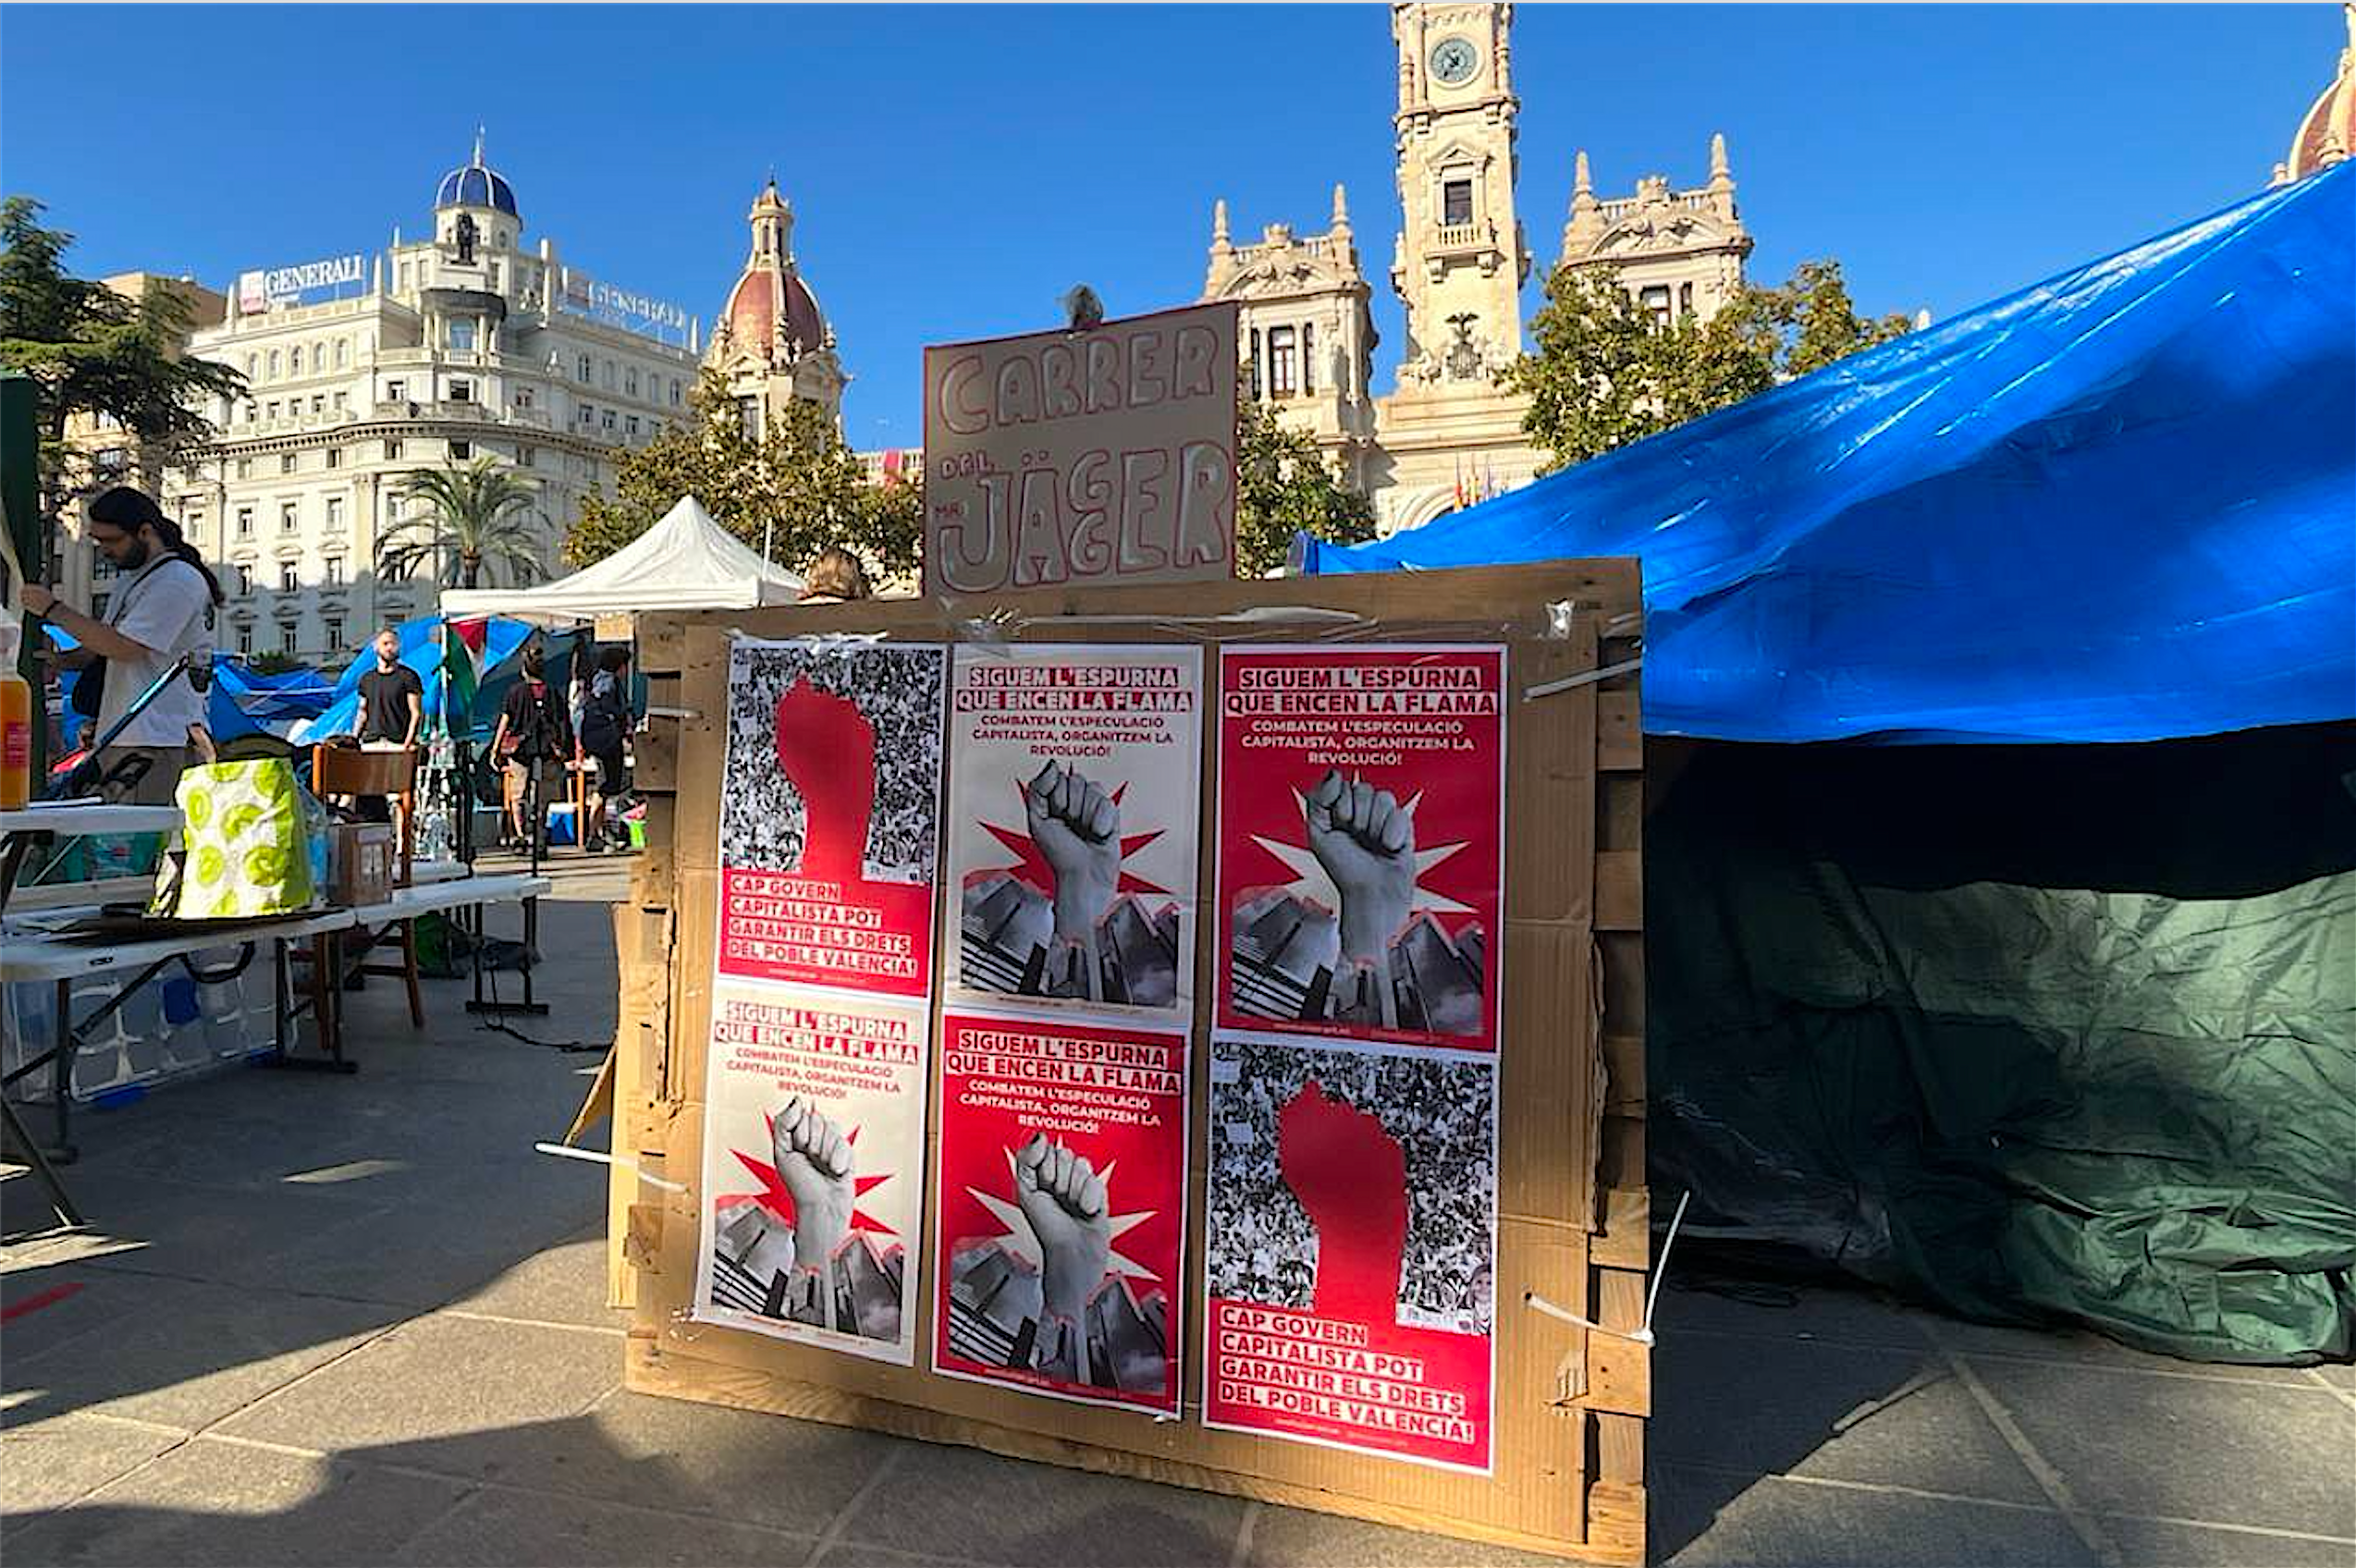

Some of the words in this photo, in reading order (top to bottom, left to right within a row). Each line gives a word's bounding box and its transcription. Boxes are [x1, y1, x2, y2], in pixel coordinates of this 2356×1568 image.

[265, 254, 362, 294] GENERALI
[940, 326, 1218, 435] CARRER
[971, 668, 1051, 687] SIGUEM
[1056, 668, 1177, 687] L'ESPURNA
[1241, 670, 1331, 688] SIGUEM
[1340, 669, 1479, 688] L'ESPURNA
[957, 692, 1000, 710] QUE
[1006, 692, 1073, 710] ENCEN
[1078, 692, 1107, 710] LA
[1113, 692, 1192, 711] FLAMA
[1227, 695, 1275, 714] QUE
[1282, 695, 1358, 712] ENCEN
[1367, 695, 1397, 712] LA
[1405, 695, 1494, 713] FLAMA
[981, 716, 1055, 726] COMBATEM
[1252, 721, 1338, 733] COMBATEM
[1343, 720, 1464, 734] L'ESPECULACIÓ
[1061, 730, 1151, 743] ORGANITZEM
[1156, 733, 1173, 743] LA
[1242, 736, 1342, 750] CAPITALISTA,
[1344, 738, 1448, 750] ORGANITZEM
[1454, 739, 1474, 750] LA
[1307, 752, 1403, 766] REVOLUCIÓ!
[731, 877, 765, 895] CAP
[770, 881, 840, 900] GOVERN
[731, 899, 839, 922] CAPITALISTA
[845, 910, 879, 925] POT
[730, 920, 815, 939] GARANTIR
[819, 929, 850, 944] ELS
[854, 933, 909, 951] DRETS
[730, 941, 758, 957] DEL
[764, 945, 818, 963] POBLE
[728, 1003, 796, 1025] SIGUEM
[801, 1011, 904, 1040] L'ESPURNA
[716, 1023, 754, 1043] QUE
[757, 1026, 817, 1051] ENCEN
[819, 1036, 844, 1055] LA
[848, 1039, 917, 1064] FLAMA
[961, 1033, 1038, 1055] SIGUEM
[1046, 1039, 1165, 1066] L'ESPURNA
[949, 1054, 989, 1072] QUE
[995, 1057, 1062, 1080] ENCEN
[1070, 1065, 1096, 1084] LA
[1103, 1070, 1178, 1092] FLAMA
[968, 1080, 1045, 1096] COMBATEM
[1048, 1086, 1150, 1110] L'ESPECULACIÓ
[960, 1094, 1048, 1114] CAPITALISTA,
[1050, 1103, 1138, 1124] ORGANITZEM
[1142, 1114, 1160, 1126] LA
[1019, 1115, 1098, 1134] REVOLUCIÓ!
[1222, 1308, 1265, 1329] CAP
[1272, 1317, 1365, 1343] GOVERN
[1222, 1334, 1367, 1370] CAPITALISTA
[1374, 1356, 1419, 1378] POT
[1222, 1359, 1334, 1390] GARANTIR
[1343, 1379, 1381, 1399] ELS
[1389, 1387, 1461, 1413] DRETS
[1222, 1384, 1260, 1403] DEL
[1268, 1390, 1341, 1417] POBLE
